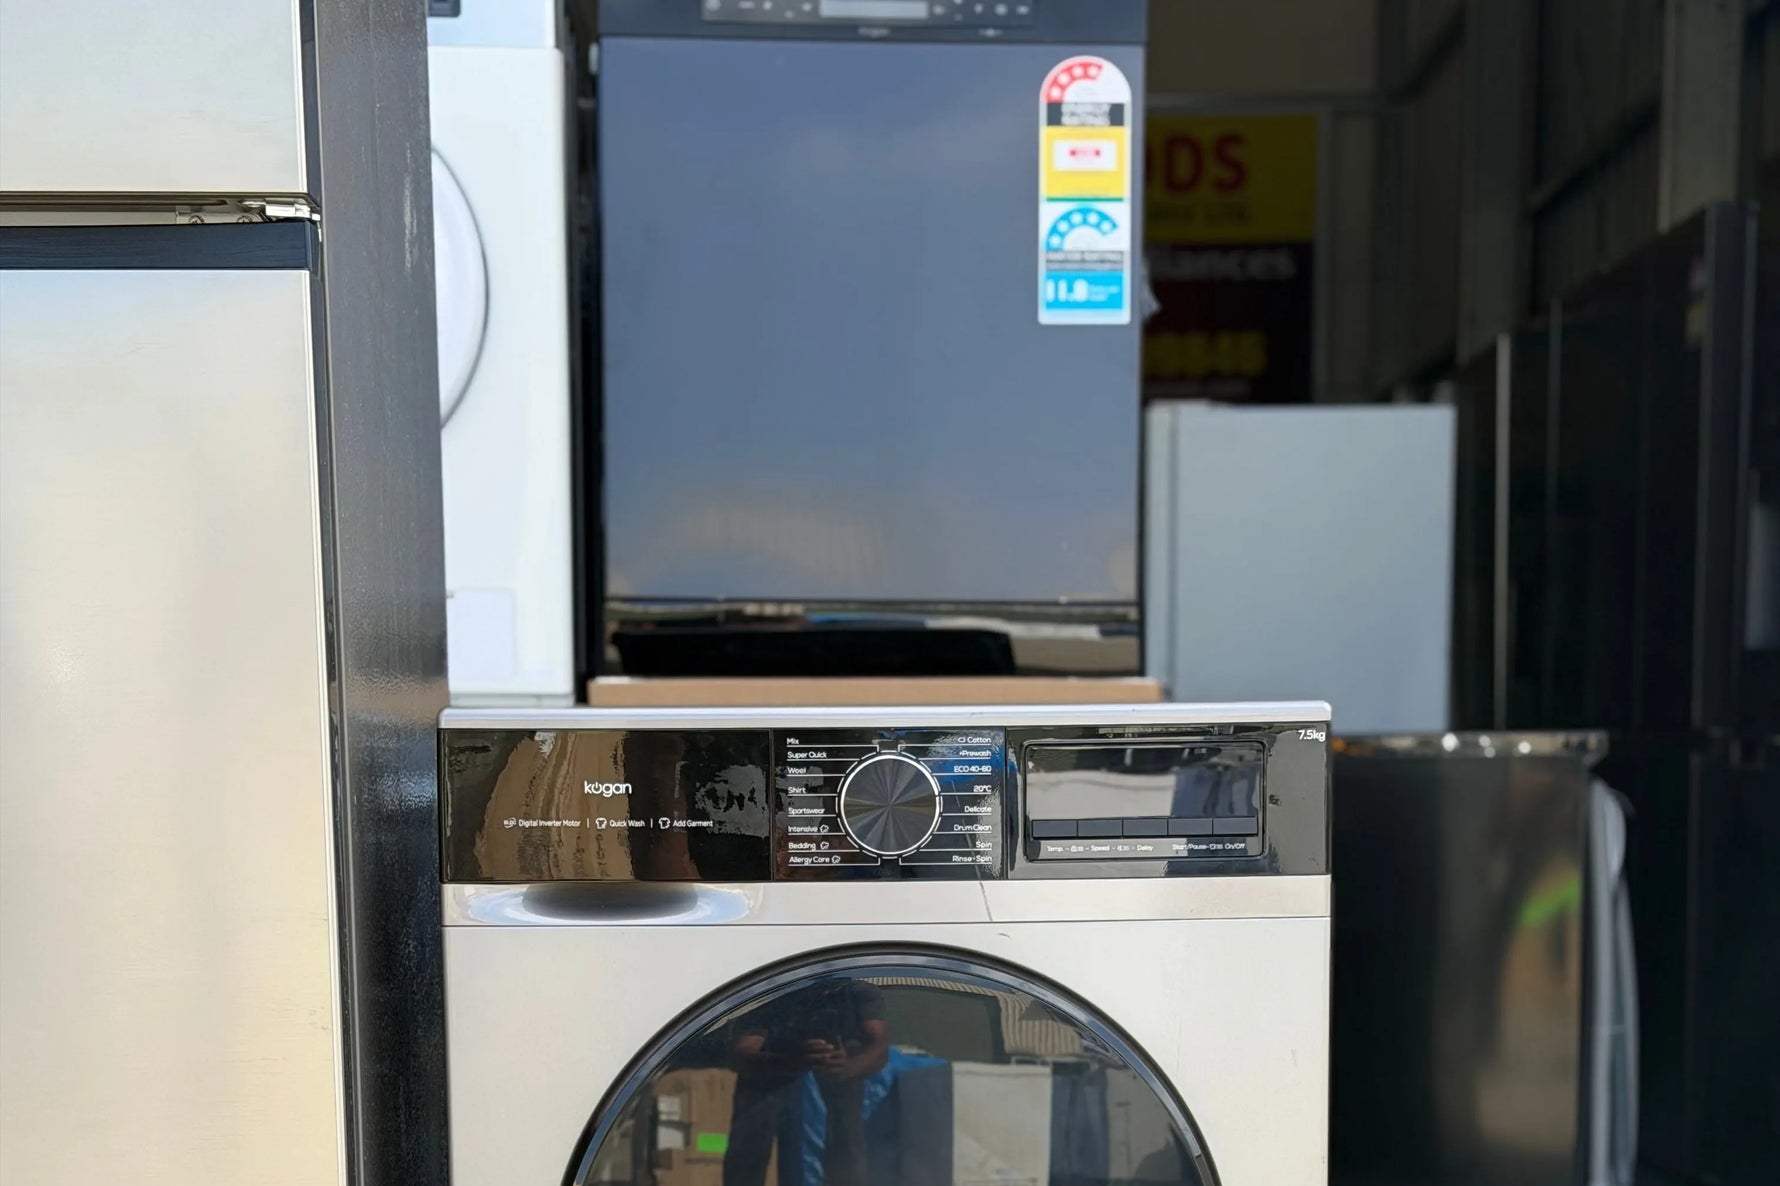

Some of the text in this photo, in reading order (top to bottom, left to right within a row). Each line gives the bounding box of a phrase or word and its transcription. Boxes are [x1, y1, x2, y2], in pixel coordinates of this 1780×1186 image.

[1145, 133, 1247, 194] DS
[1298, 729, 1326, 742] 7.5kg
[786, 737, 800, 745] Mix
[787, 751, 828, 759] Super Quick
[953, 765, 970, 773] ECO
[584, 780, 633, 798] kogan
[788, 786, 806, 794] Shirt
[788, 807, 826, 815] Sportswear
[964, 805, 992, 813] Delicate
[518, 819, 581, 828] Digital Inverter Motor
[609, 819, 645, 828] Quick Wash
[672, 819, 713, 827] Add Garment
[788, 842, 817, 851] Bedding
[975, 841, 992, 849] Spin
[789, 856, 812, 865] Allergy
